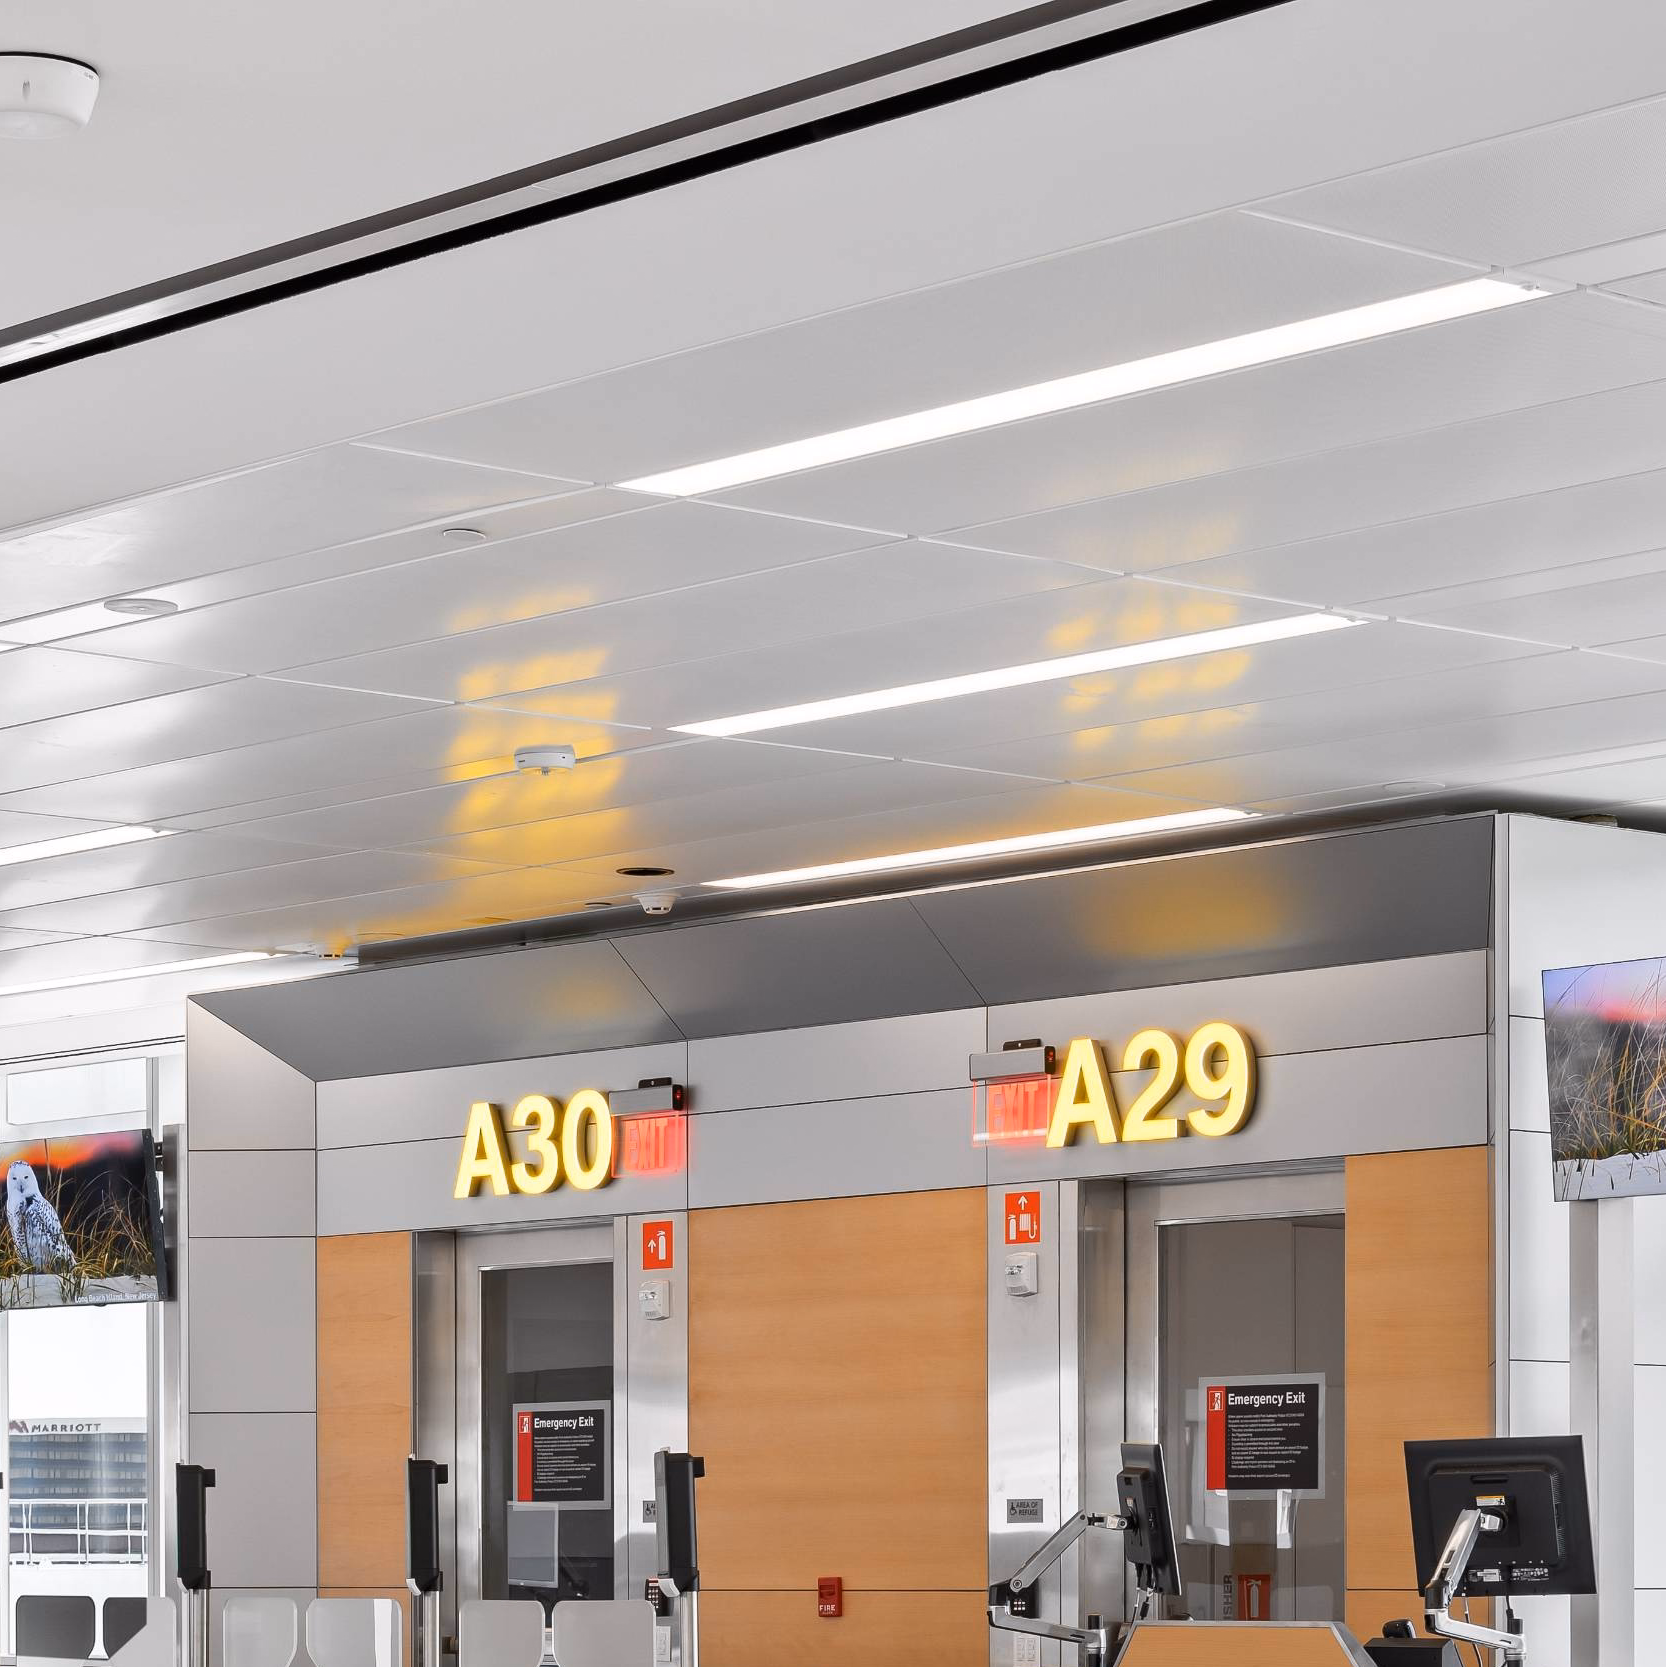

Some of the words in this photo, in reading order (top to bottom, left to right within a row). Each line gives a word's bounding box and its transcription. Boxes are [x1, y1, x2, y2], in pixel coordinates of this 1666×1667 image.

[1045, 1022, 1254, 1148] A29
[988, 1082, 1039, 1132] EXIT
[453, 1089, 614, 1199] A30
[624, 1118, 668, 1170] EXIT
[74, 1295, 89, 1304] Long
[89, 1294, 105, 1302] Beach
[1228, 1393, 1284, 1407] Emergency
[1286, 1391, 1306, 1404] Exit
[31, 1423, 101, 1433] MARRIOTT
[534, 1418, 577, 1431] Emergency
[578, 1415, 594, 1427] Exit
[819, 1604, 836, 1612] FIRE
